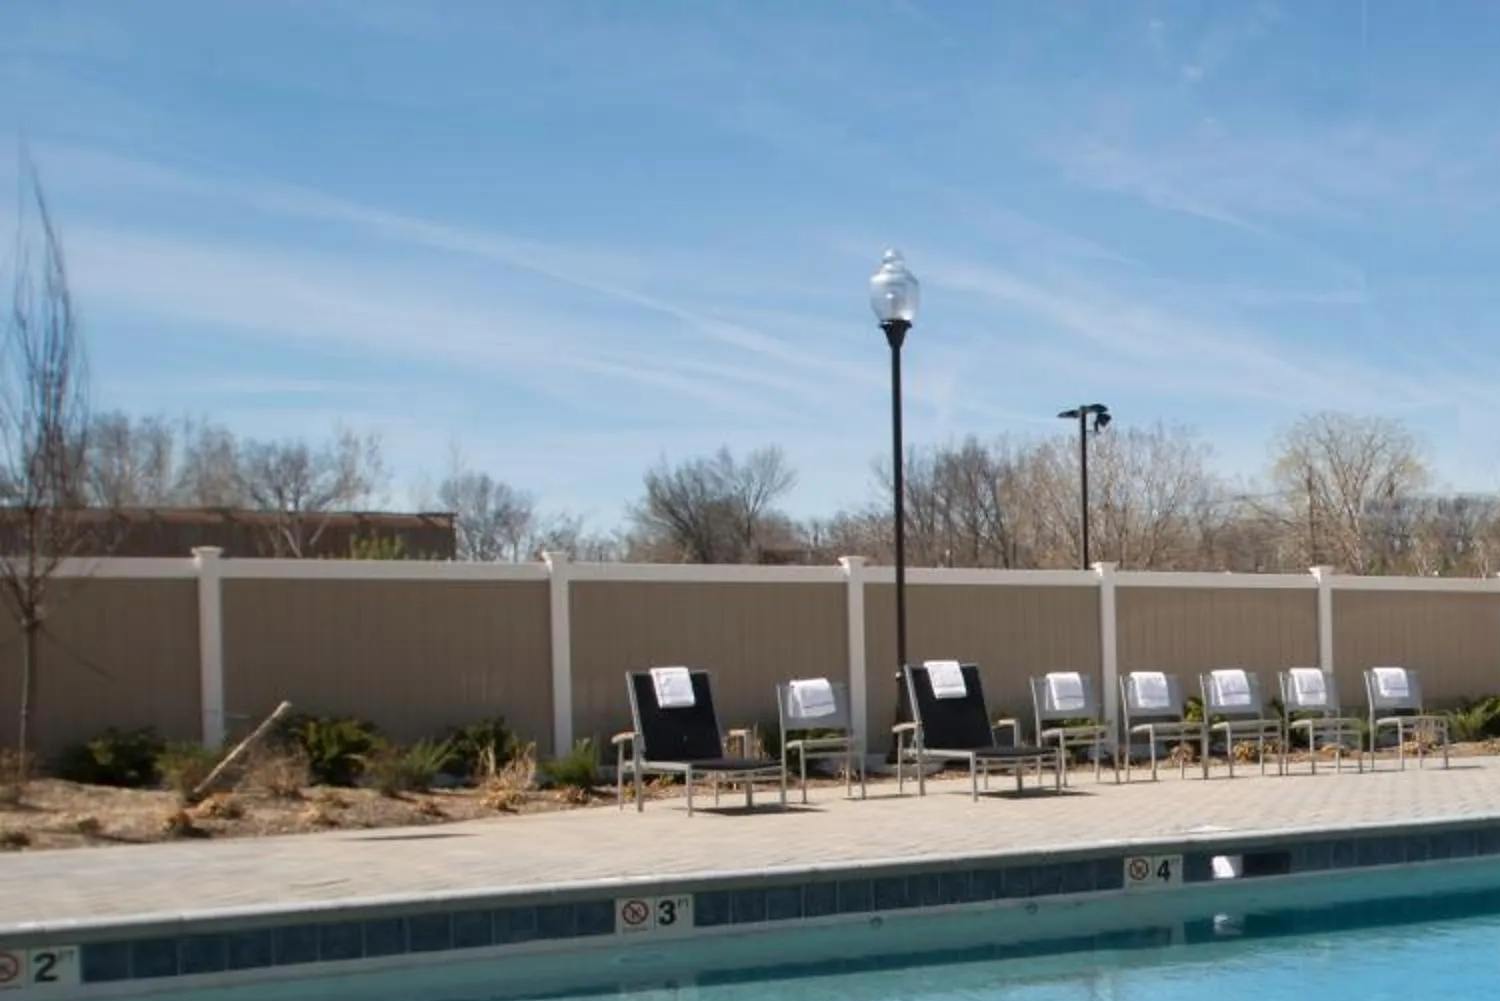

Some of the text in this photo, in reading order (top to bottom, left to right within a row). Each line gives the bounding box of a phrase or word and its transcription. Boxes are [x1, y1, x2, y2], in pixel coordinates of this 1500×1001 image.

[1156, 860, 1171, 881] 4
[659, 900, 676, 925] 3
[33, 952, 57, 984] 2
